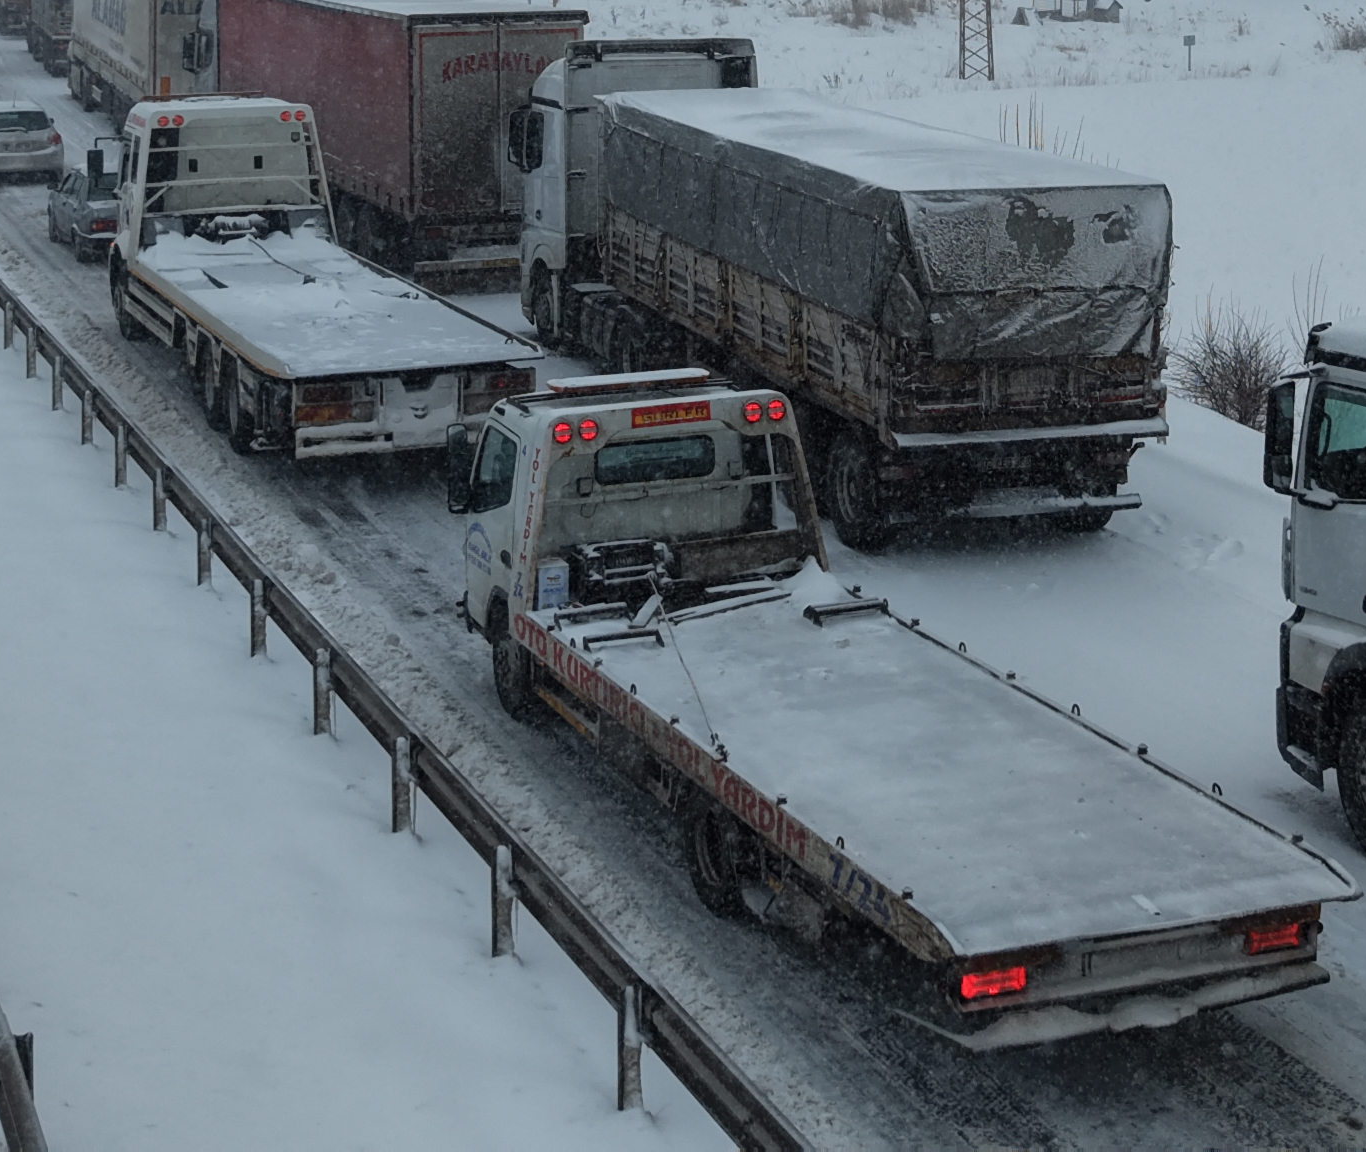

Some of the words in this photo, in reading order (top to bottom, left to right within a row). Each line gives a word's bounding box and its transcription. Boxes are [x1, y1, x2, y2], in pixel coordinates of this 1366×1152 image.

[442, 51, 555, 84] KARATAYLA
[513, 613, 548, 658] OTO
[710, 762, 808, 861] YARDIM
